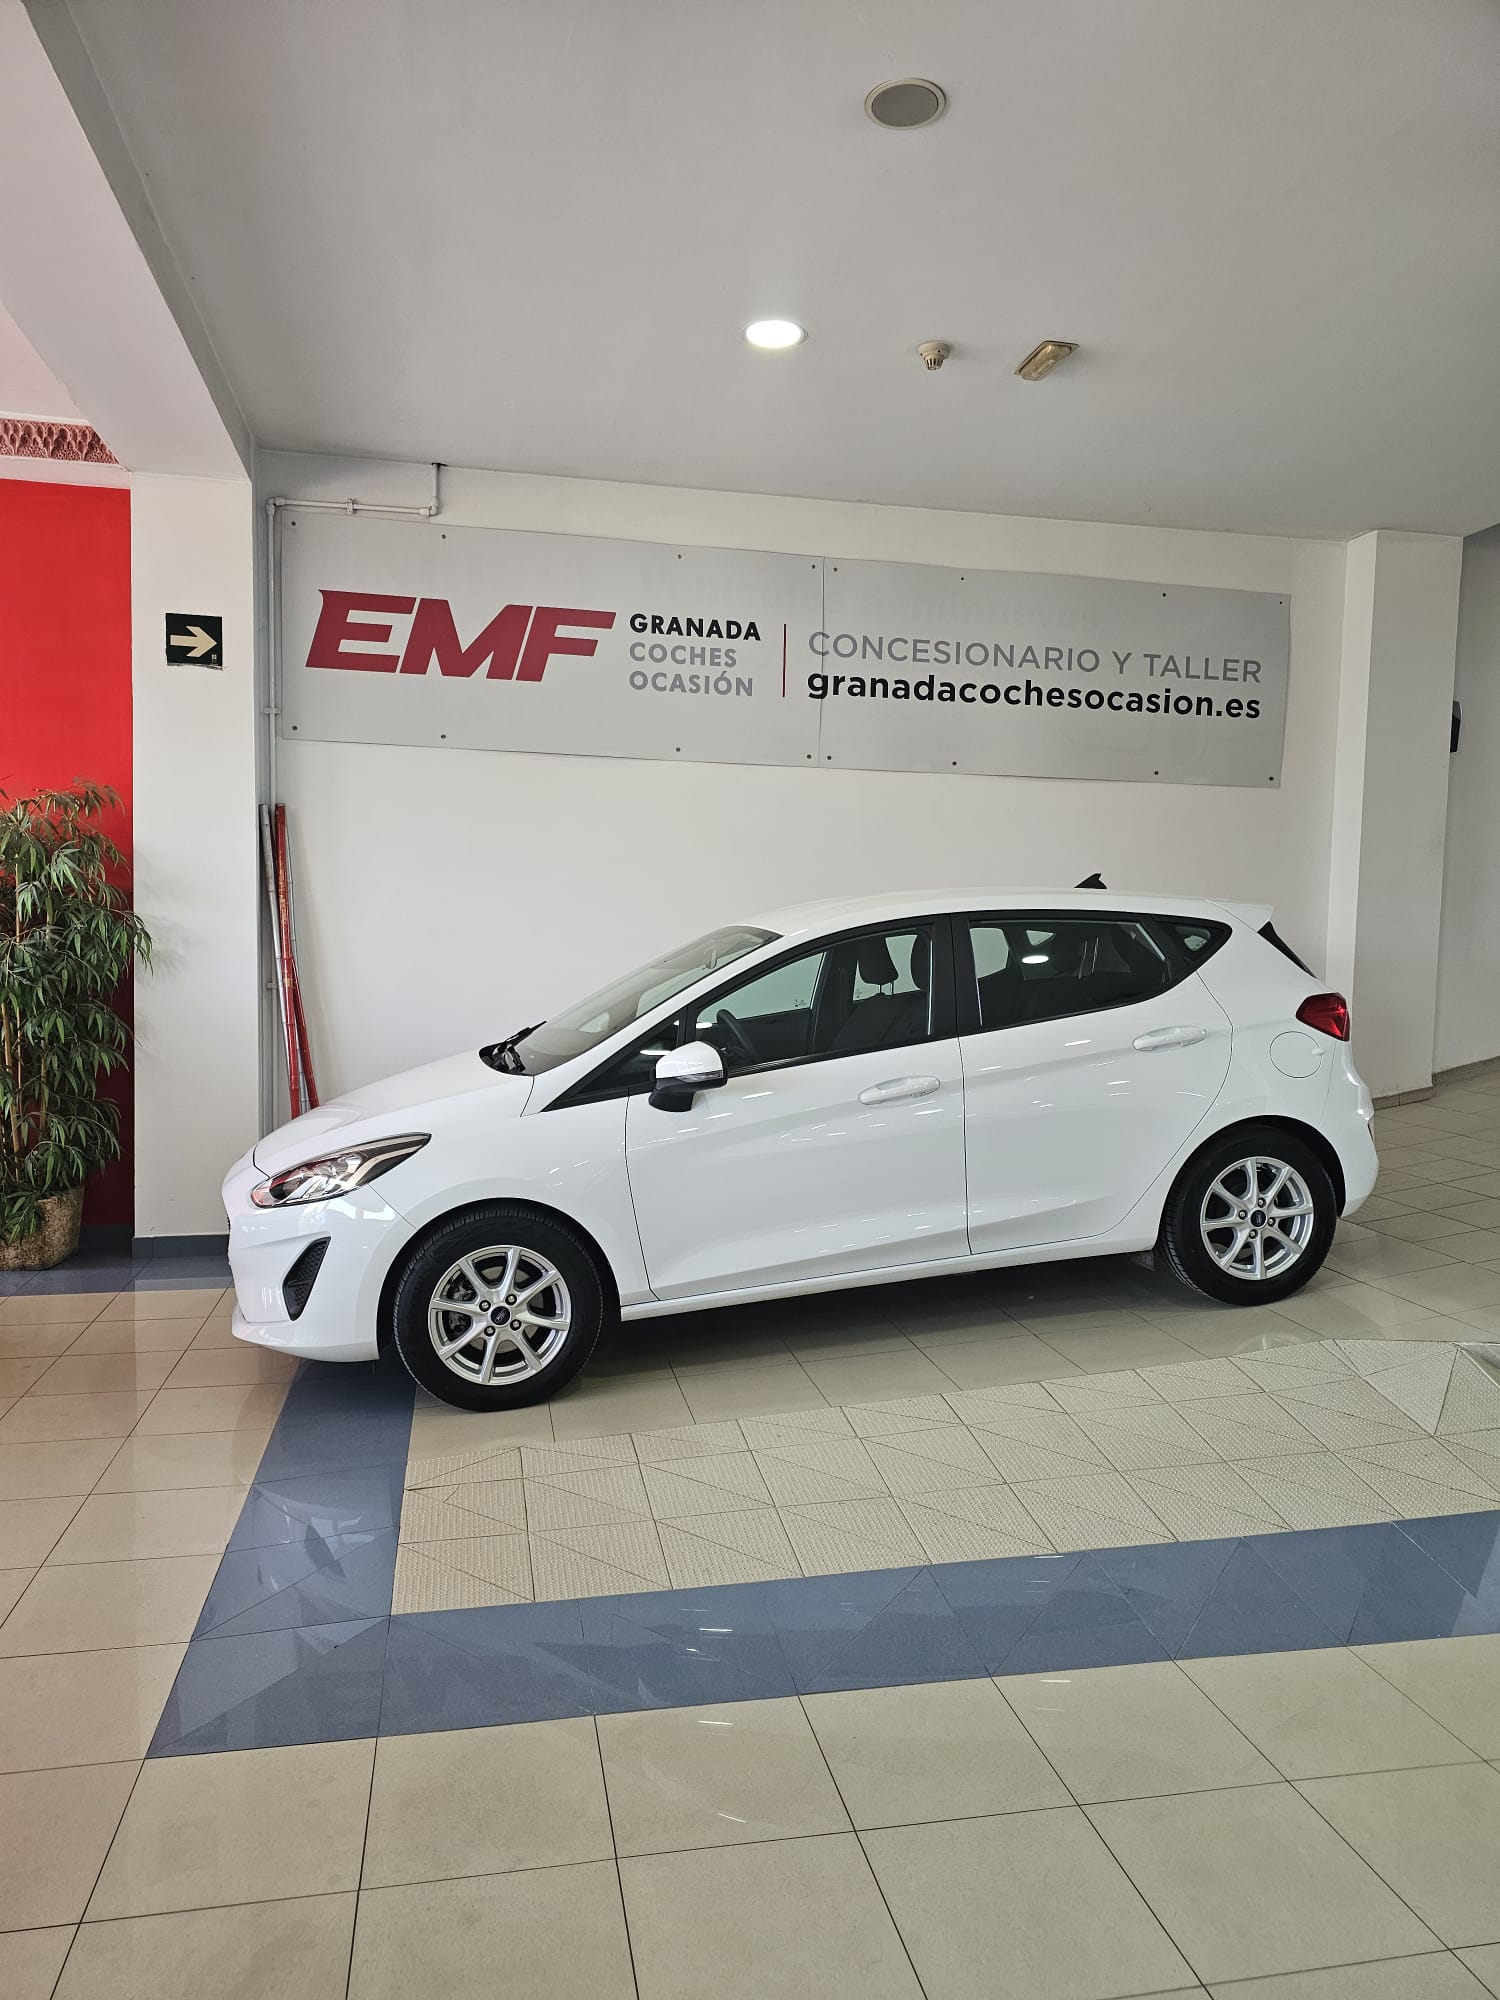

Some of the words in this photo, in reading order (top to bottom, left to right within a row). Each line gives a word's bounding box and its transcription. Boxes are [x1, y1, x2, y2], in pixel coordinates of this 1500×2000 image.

[305, 589, 617, 682] EMF
[629, 613, 761, 641] GRANADA
[629, 642, 738, 668] COCHES
[808, 631, 1100, 673] CONCESIONARIO
[1112, 651, 1132, 675] Y
[1143, 653, 1262, 683] TALLER
[629, 671, 754, 697] OCASIÓN
[807, 672, 1261, 719] granadacochesocasion.es
